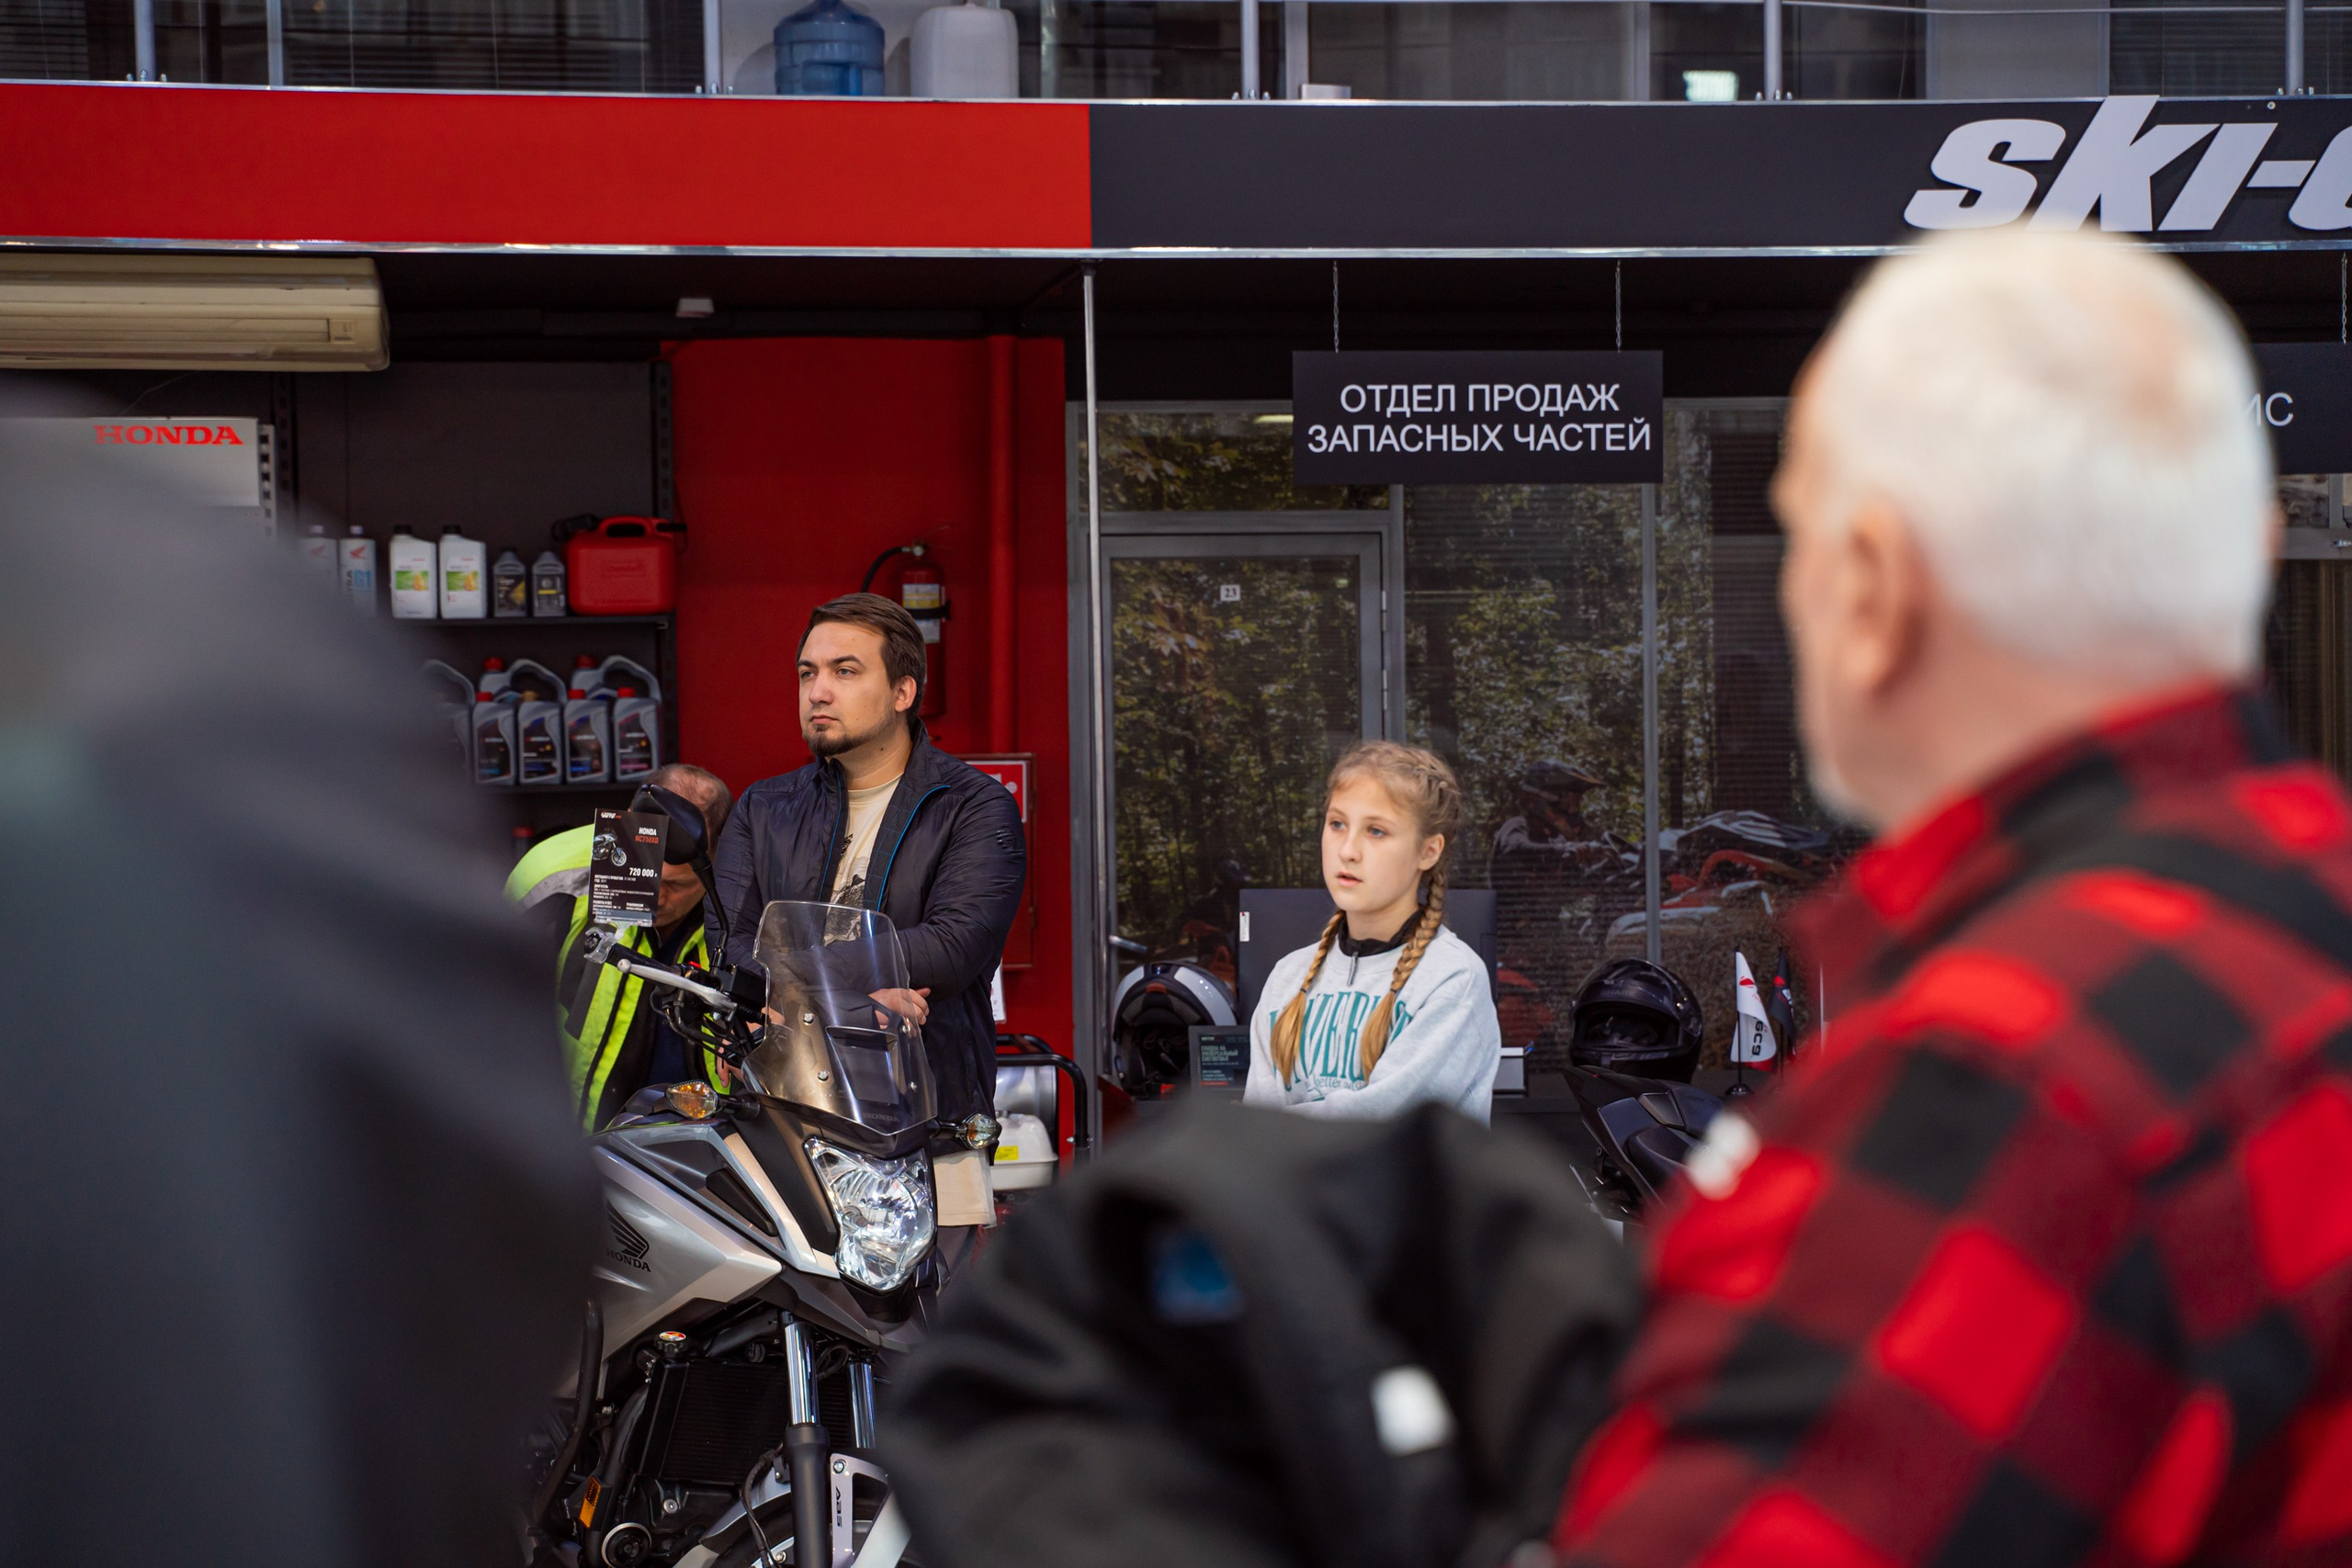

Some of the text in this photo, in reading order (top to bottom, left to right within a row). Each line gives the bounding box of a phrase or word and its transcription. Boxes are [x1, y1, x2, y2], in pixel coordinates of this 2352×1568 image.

[1340, 384, 1620, 418] ОТДЕЛ ПРОДАЖ
[93, 424, 244, 446] HONDA
[1306, 417, 1651, 453] ЗАПАСНЫХ ЧАСТЕЙ
[639, 827, 657, 836] HONDA
[628, 867, 641, 876] 720
[641, 869, 654, 877] 000
[862, 1112, 900, 1122] HONDA
[606, 1249, 652, 1273] HONDA
